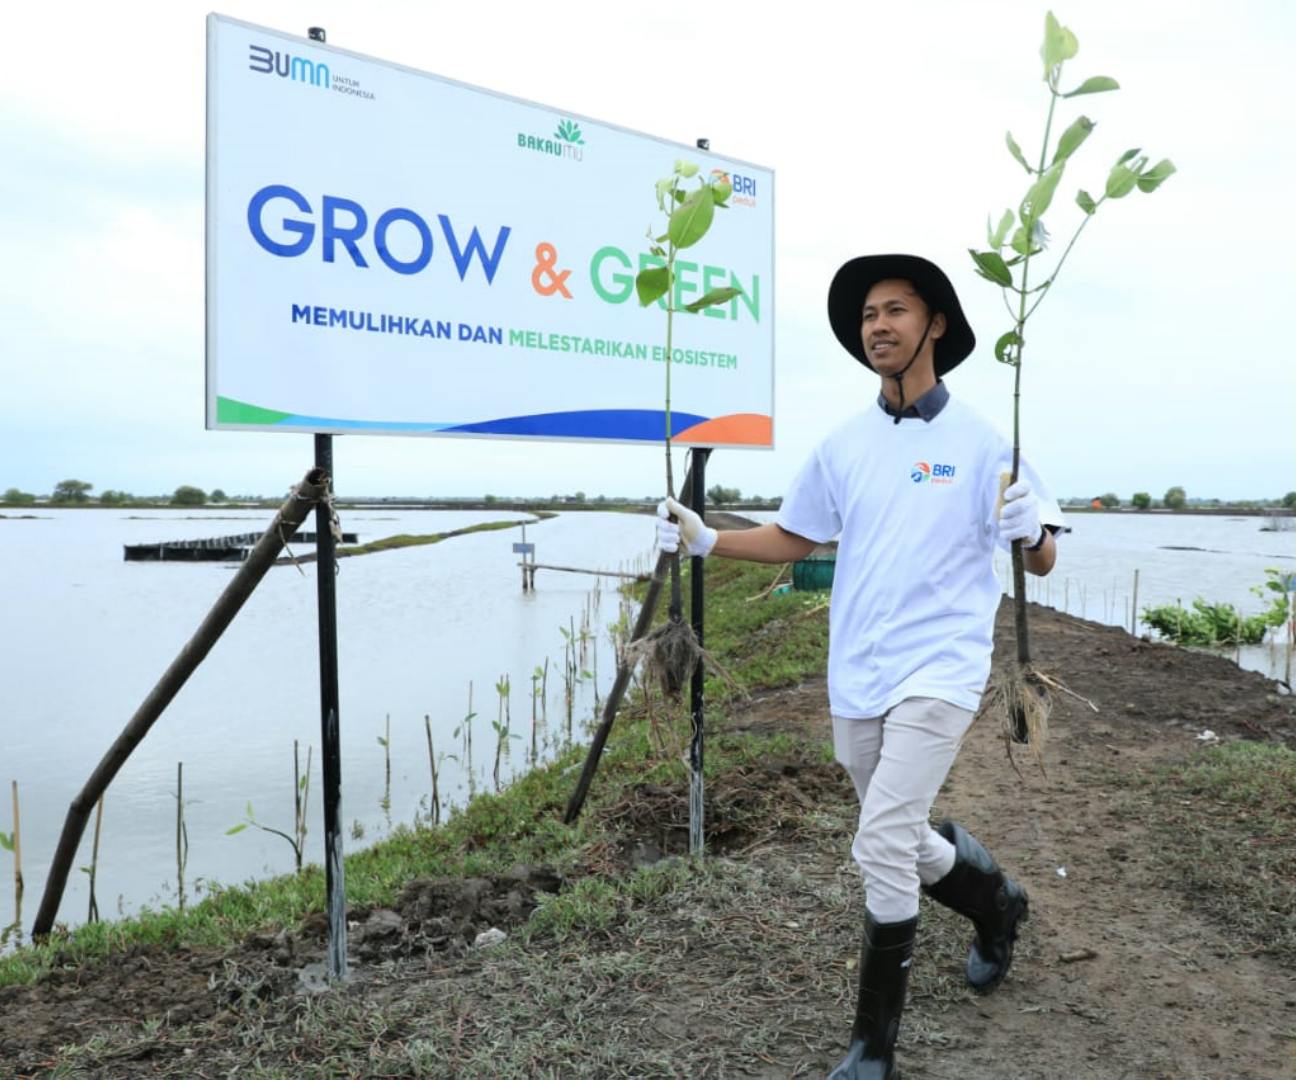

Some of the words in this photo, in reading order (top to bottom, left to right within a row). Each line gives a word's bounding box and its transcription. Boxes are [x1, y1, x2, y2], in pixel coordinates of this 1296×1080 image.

[332, 84, 376, 100] INDONESIA
[733, 174, 756, 196] BRI
[247, 184, 511, 285] GROW
[531, 241, 573, 299] &
[291, 304, 451, 340] MEMULIHKAN
[458, 323, 503, 345] DAN
[509, 329, 647, 361] MELESTARIKAN
[933, 464, 956, 477] BRI
